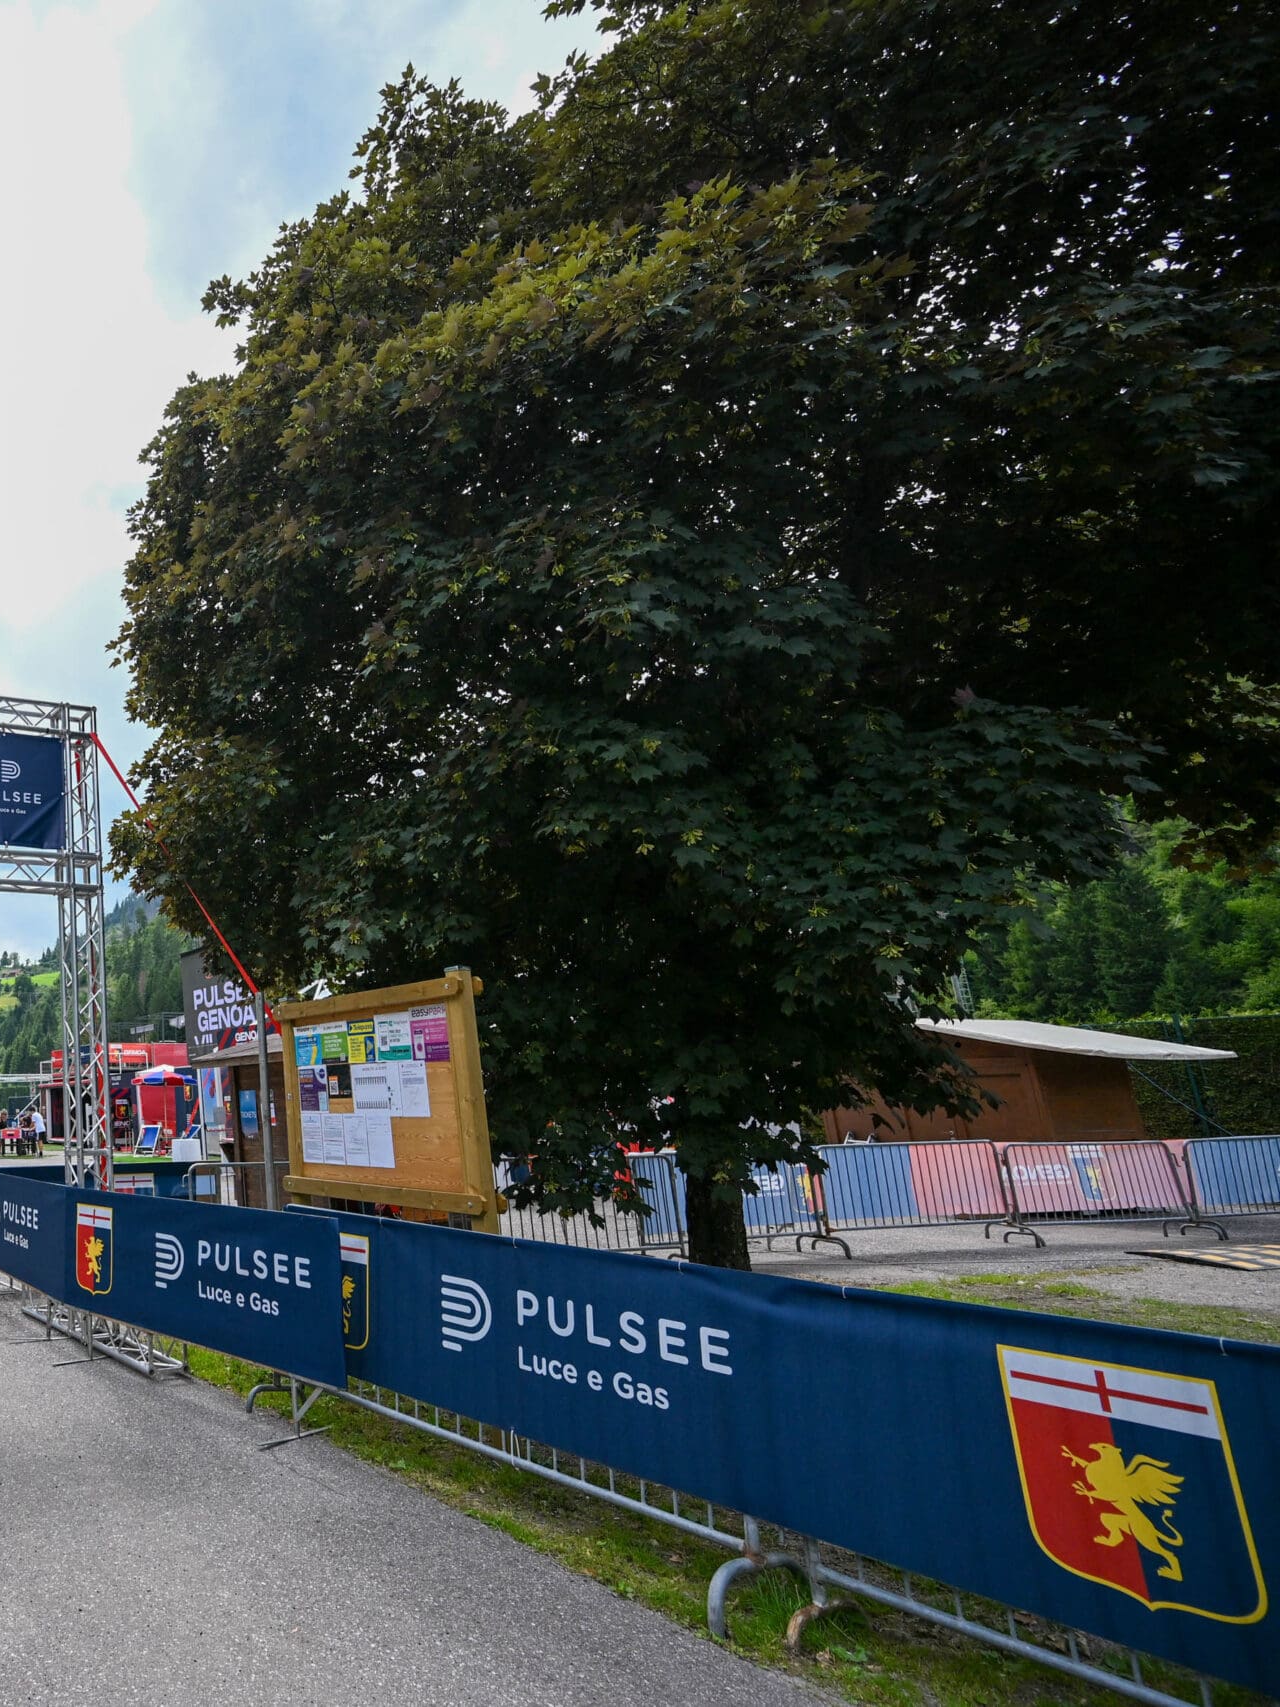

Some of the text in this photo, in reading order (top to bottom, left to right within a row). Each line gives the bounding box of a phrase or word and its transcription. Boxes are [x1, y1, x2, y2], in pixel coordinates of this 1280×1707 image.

[193, 981, 245, 1011] PULSE
[198, 1004, 258, 1032] GENOA
[234, 1031, 259, 1042] GENO
[3, 1200, 39, 1230] PULSEE
[4, 1228, 15, 1244] Luce
[19, 1234, 29, 1249] Gas
[197, 1239, 312, 1289] PULSEE
[198, 1280, 280, 1316] Luce e Gas
[516, 1289, 733, 1376] PULSEE
[518, 1345, 670, 1410] Luce e Gas
